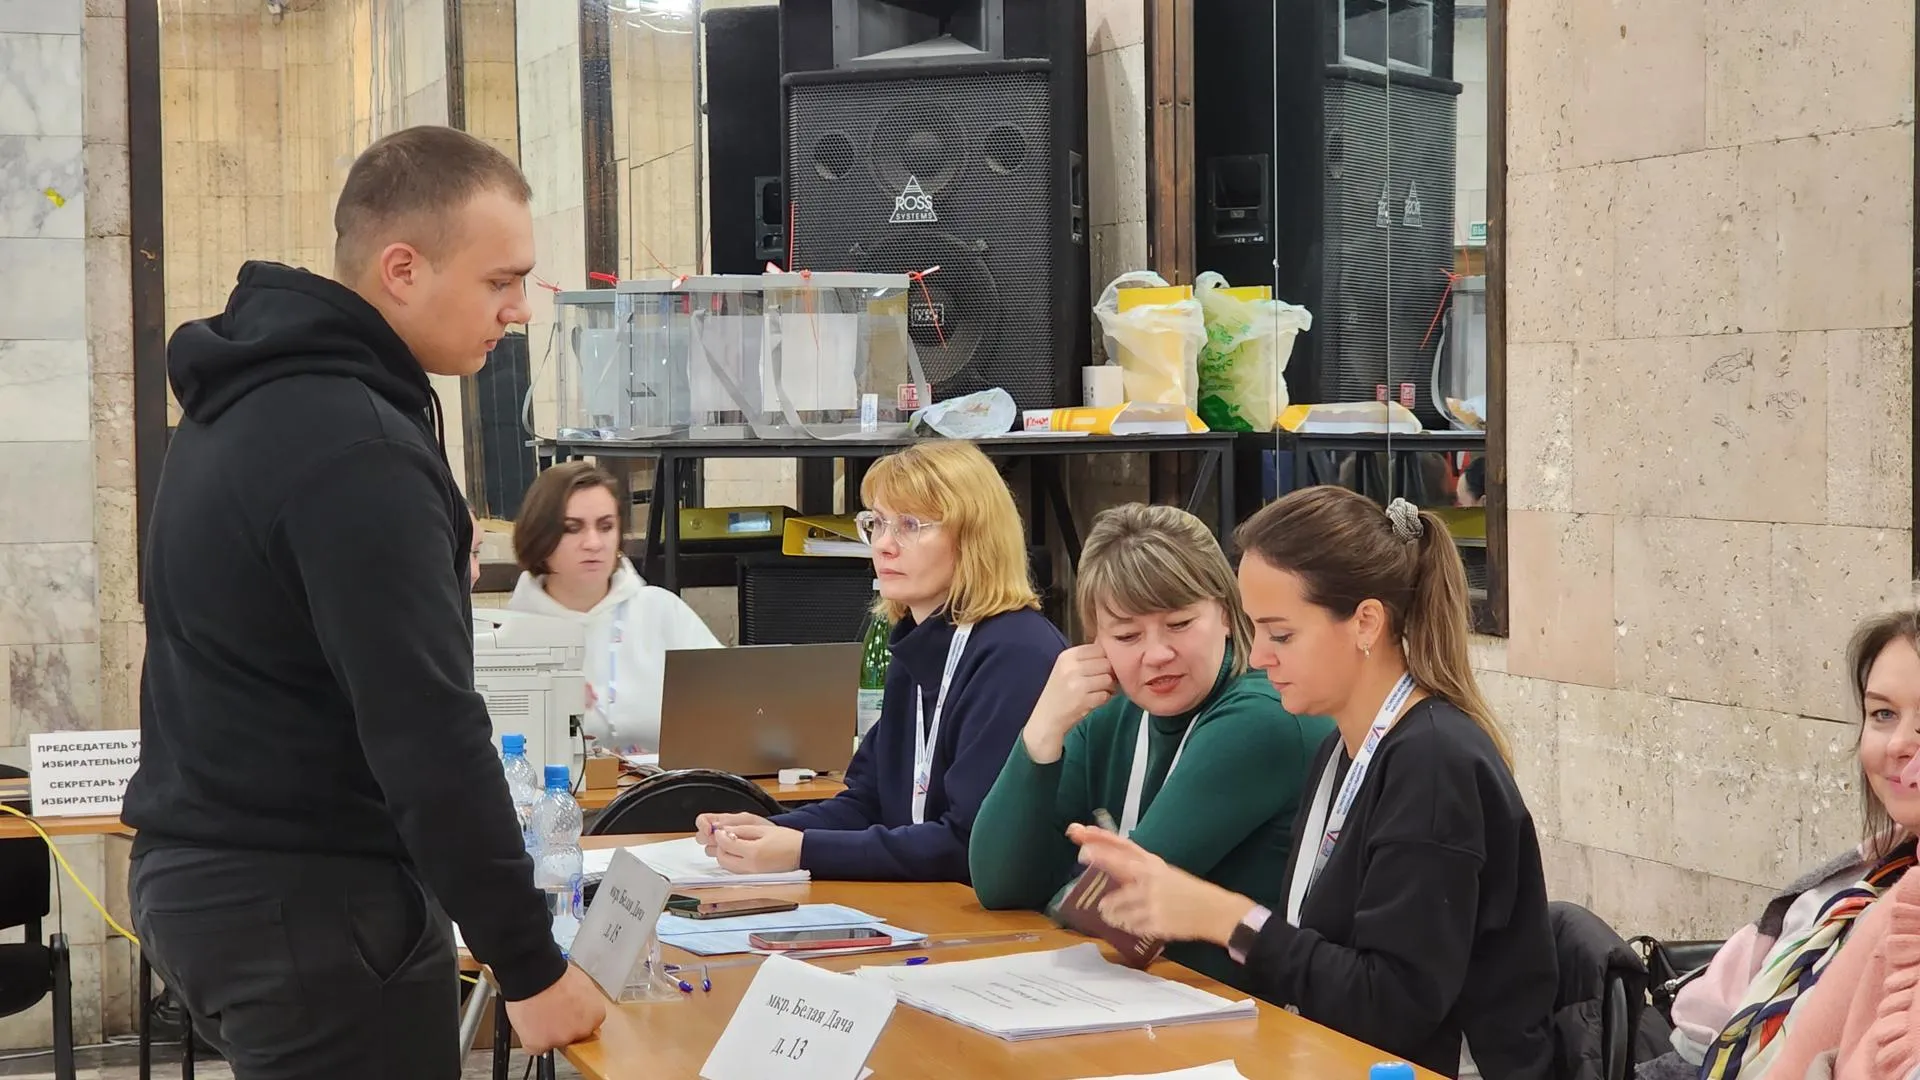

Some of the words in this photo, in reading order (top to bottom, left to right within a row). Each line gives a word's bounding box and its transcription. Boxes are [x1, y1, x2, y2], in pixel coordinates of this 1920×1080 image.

[896, 195, 932, 210] ROSS
[896, 212, 932, 220] SYSTEMS
[38, 742, 128, 753] ПРЕДСЕДАТЕЛЬ
[50, 779, 115, 789] СЕКРЕТАРЬ
[767, 994, 789, 1015] мкр.
[791, 998, 826, 1024] Белая
[822, 1009, 854, 1033] Дача
[769, 1037, 785, 1056] д.
[787, 1036, 808, 1060] 13
